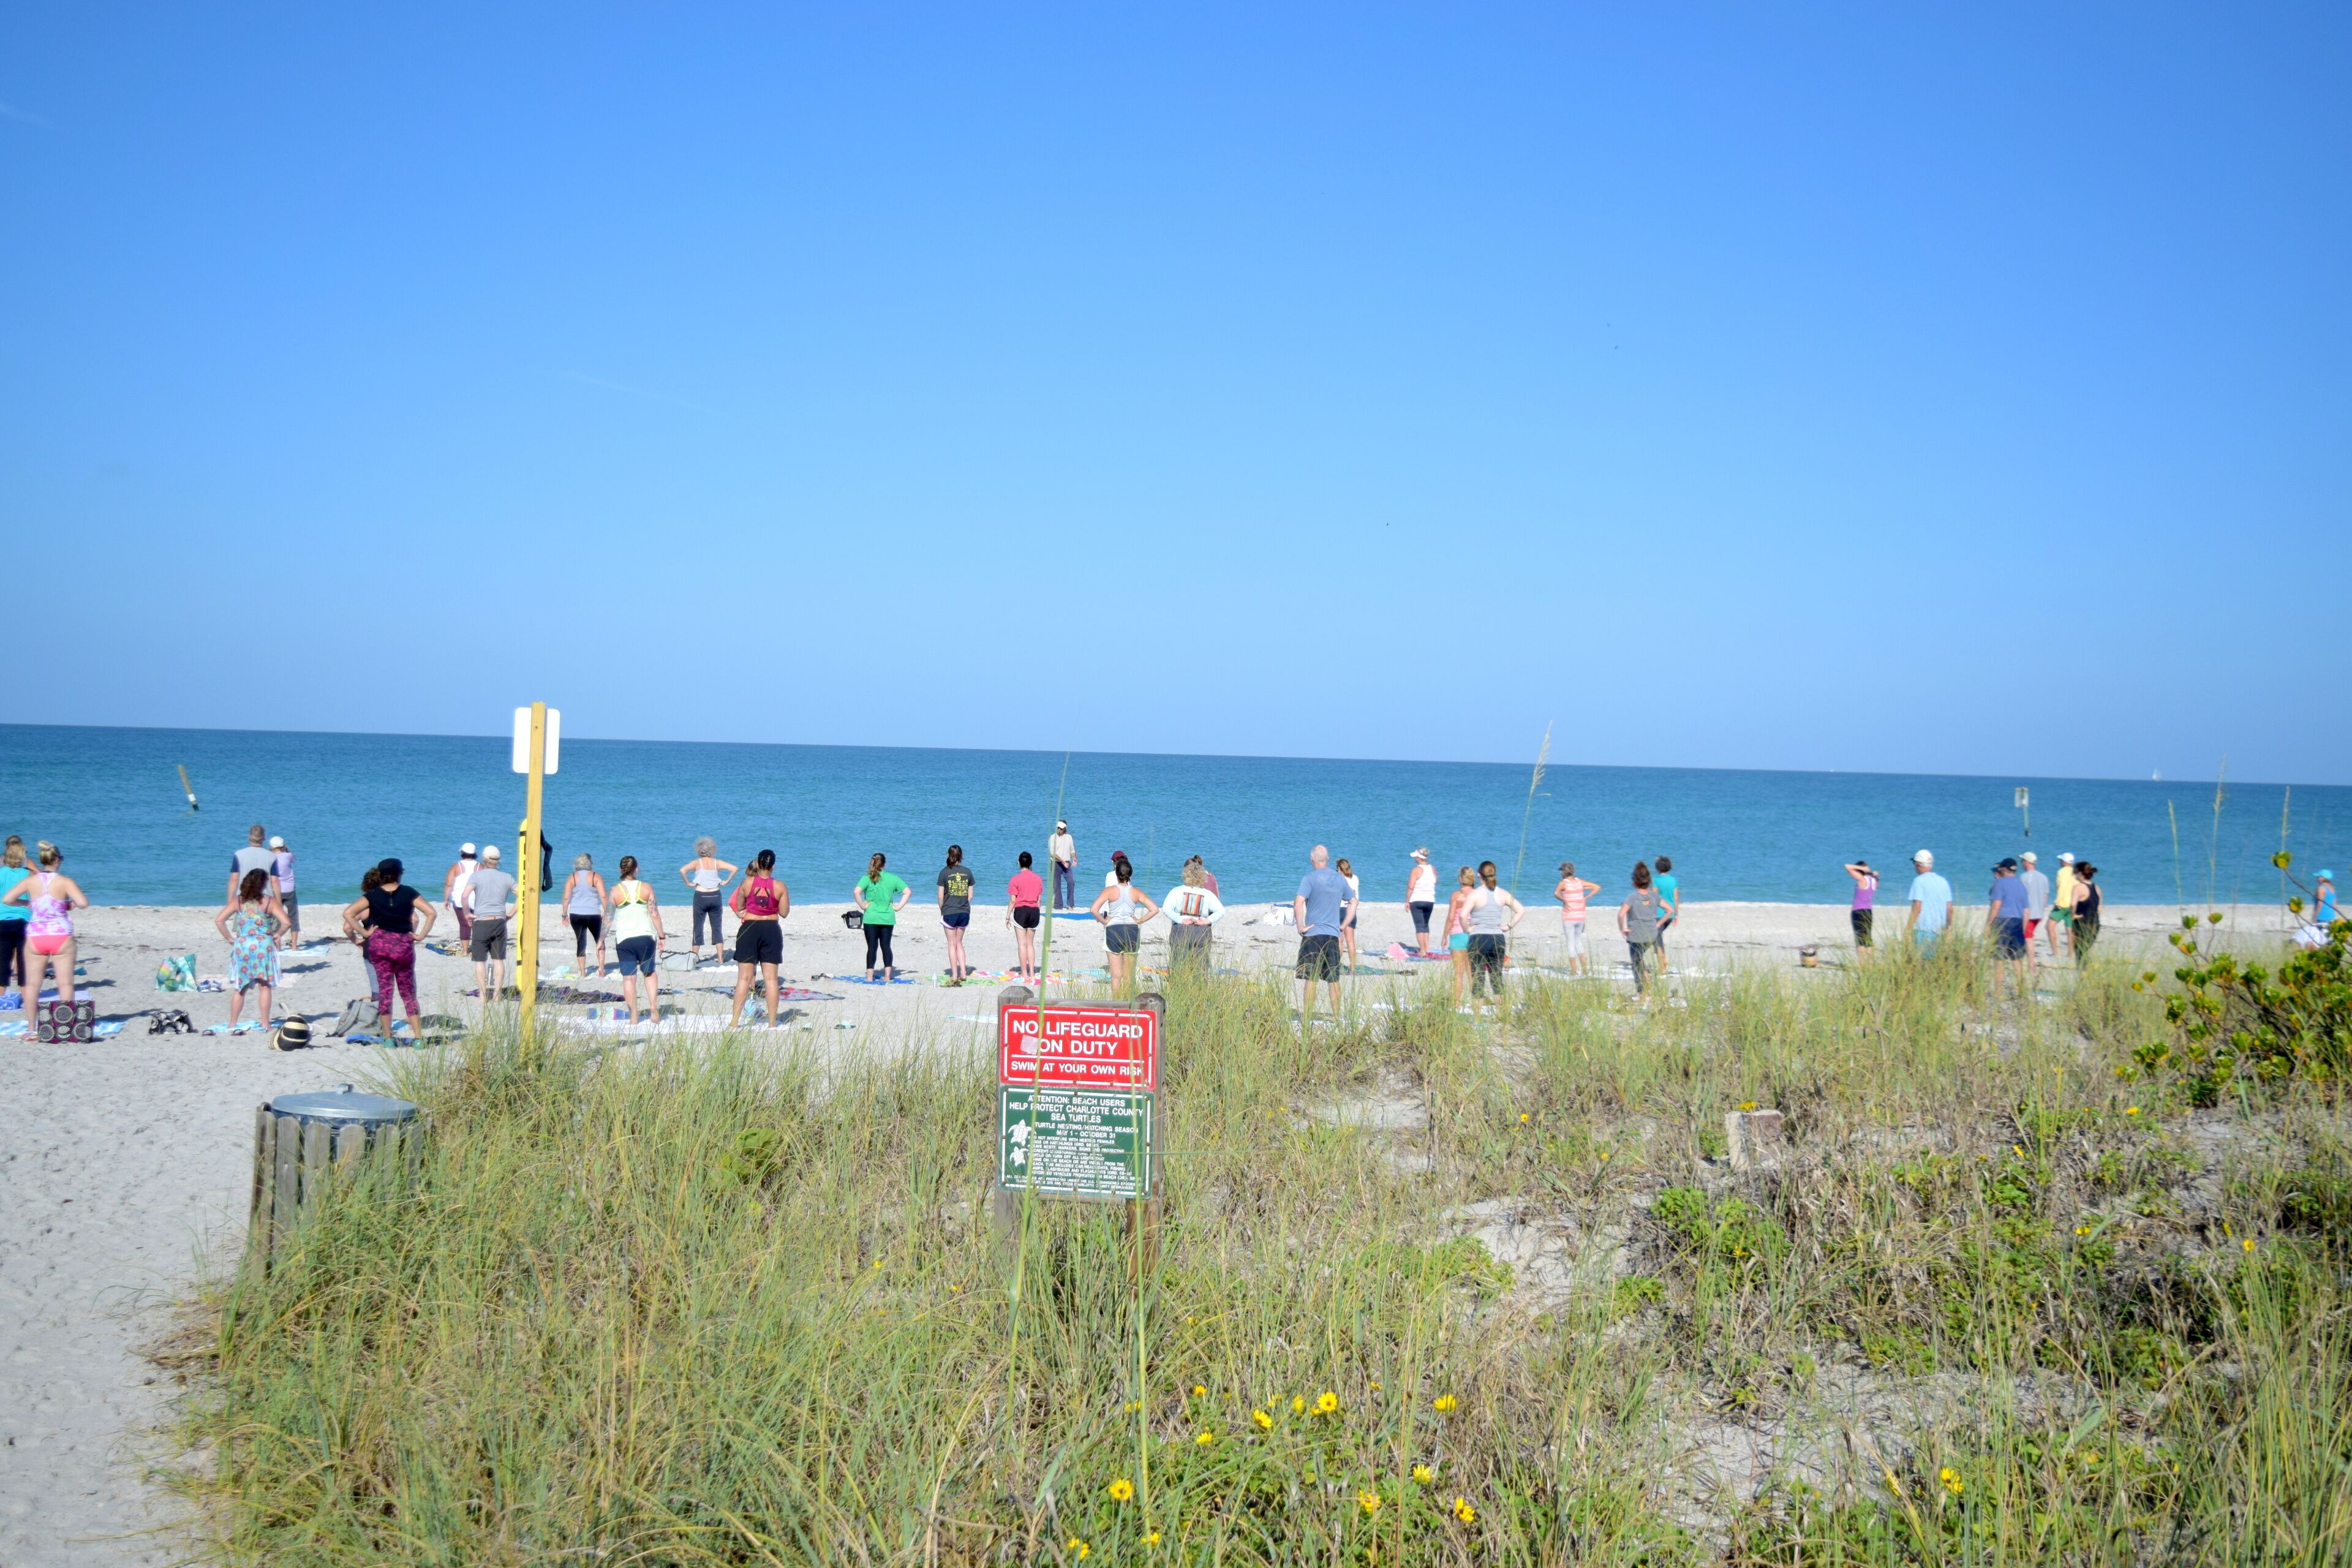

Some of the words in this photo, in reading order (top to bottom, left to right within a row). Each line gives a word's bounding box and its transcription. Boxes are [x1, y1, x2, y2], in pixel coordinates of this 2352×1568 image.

[1013, 1020, 1039, 1034] NO
[1046, 1022, 1143, 1038] LIFEGUARD
[1039, 1039, 1063, 1052] ON
[1071, 1040, 1118, 1055] DUTY
[1011, 1061, 1038, 1071] SWIM
[1042, 1063, 1055, 1071] AT
[1058, 1063, 1087, 1073] YOUR
[1091, 1065, 1115, 1074] OWN
[1120, 1066, 1142, 1076] RISK
[1028, 1095, 1069, 1104] ATENTION:
[1030, 1103, 1063, 1112] PROTECT
[1066, 1105, 1109, 1115] CHARLOTTE
[1069, 1114, 1101, 1123] TURTLES
[1058, 1123, 1112, 1132] NESTING/HATCHING
